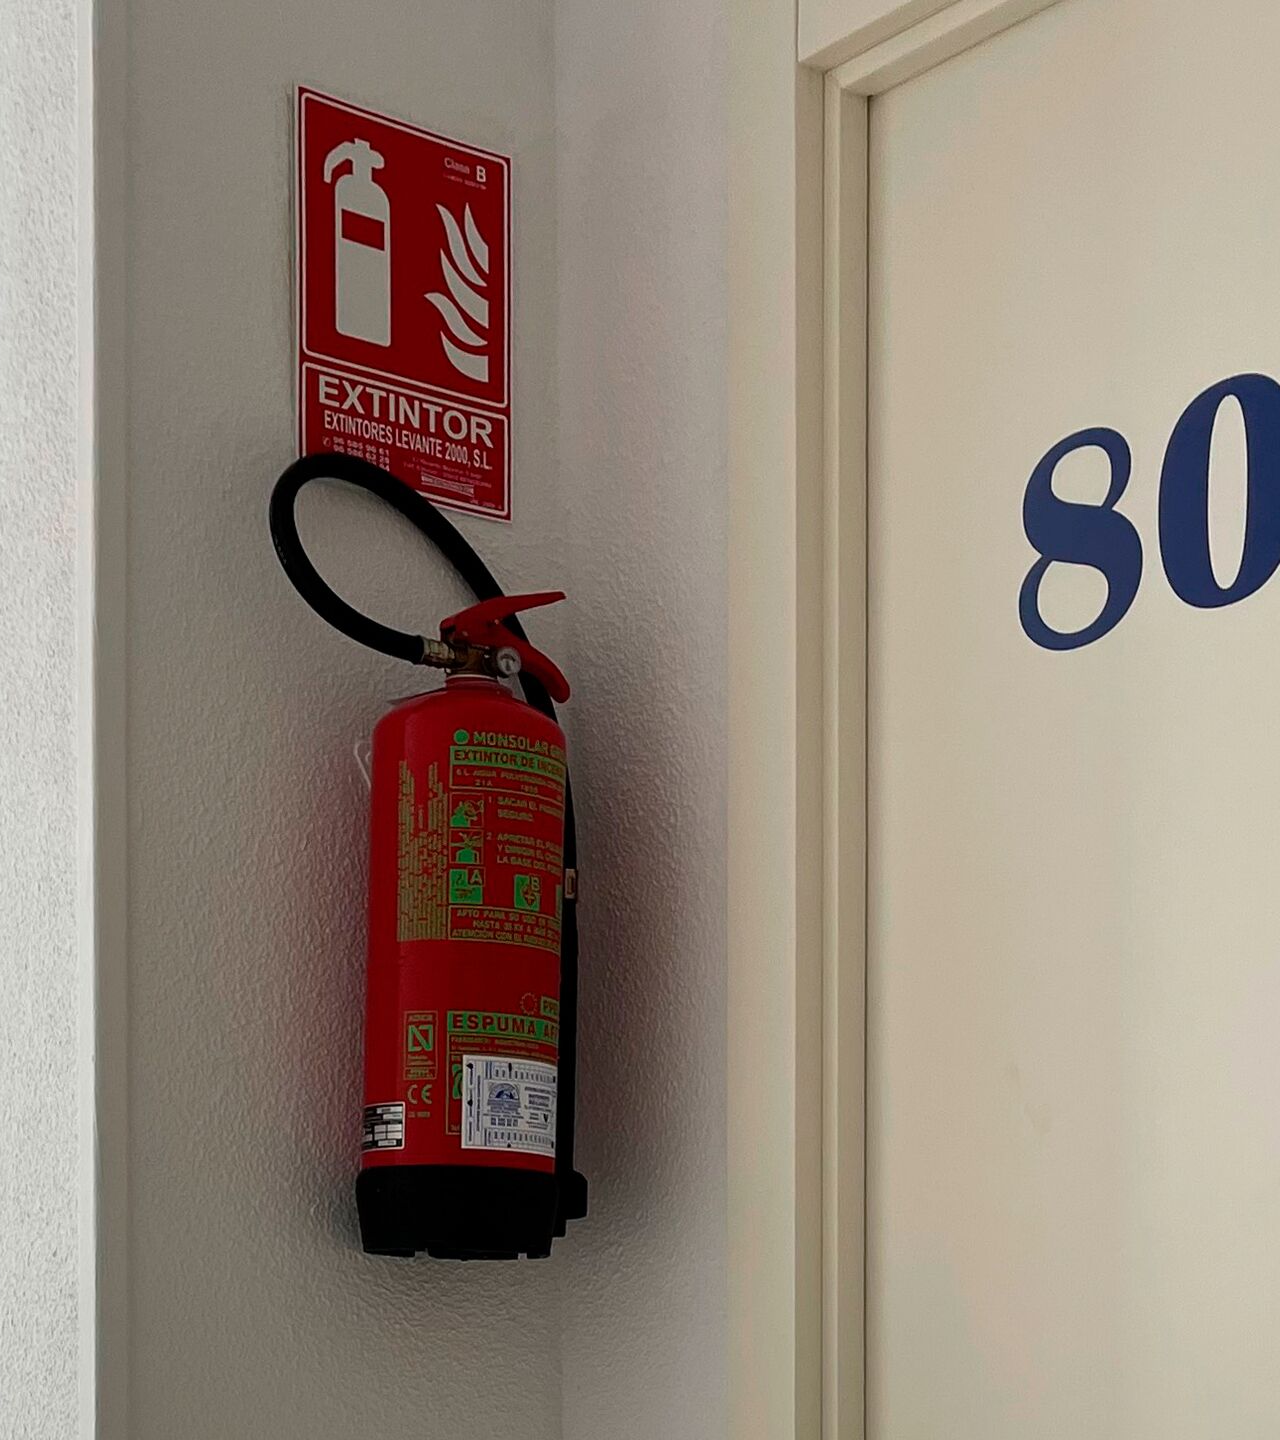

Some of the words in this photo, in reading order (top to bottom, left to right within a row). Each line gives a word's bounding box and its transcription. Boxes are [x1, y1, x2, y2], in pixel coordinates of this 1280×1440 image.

[476, 165, 487, 183] B
[318, 373, 494, 448] EXTINTOR
[324, 410, 393, 445] EXTINTORES
[395, 429, 443, 458] LEVANTE
[444, 442, 471, 468] 2000,
[473, 730, 549, 755] MONSOLAR
[454, 749, 518, 767] EXTINTOR
[521, 756, 535, 768] DE
[469, 869, 483, 885] A
[531, 876, 540, 892] B
[452, 1013, 536, 1035] ESPUMA
[407, 1084, 433, 1105] CE
